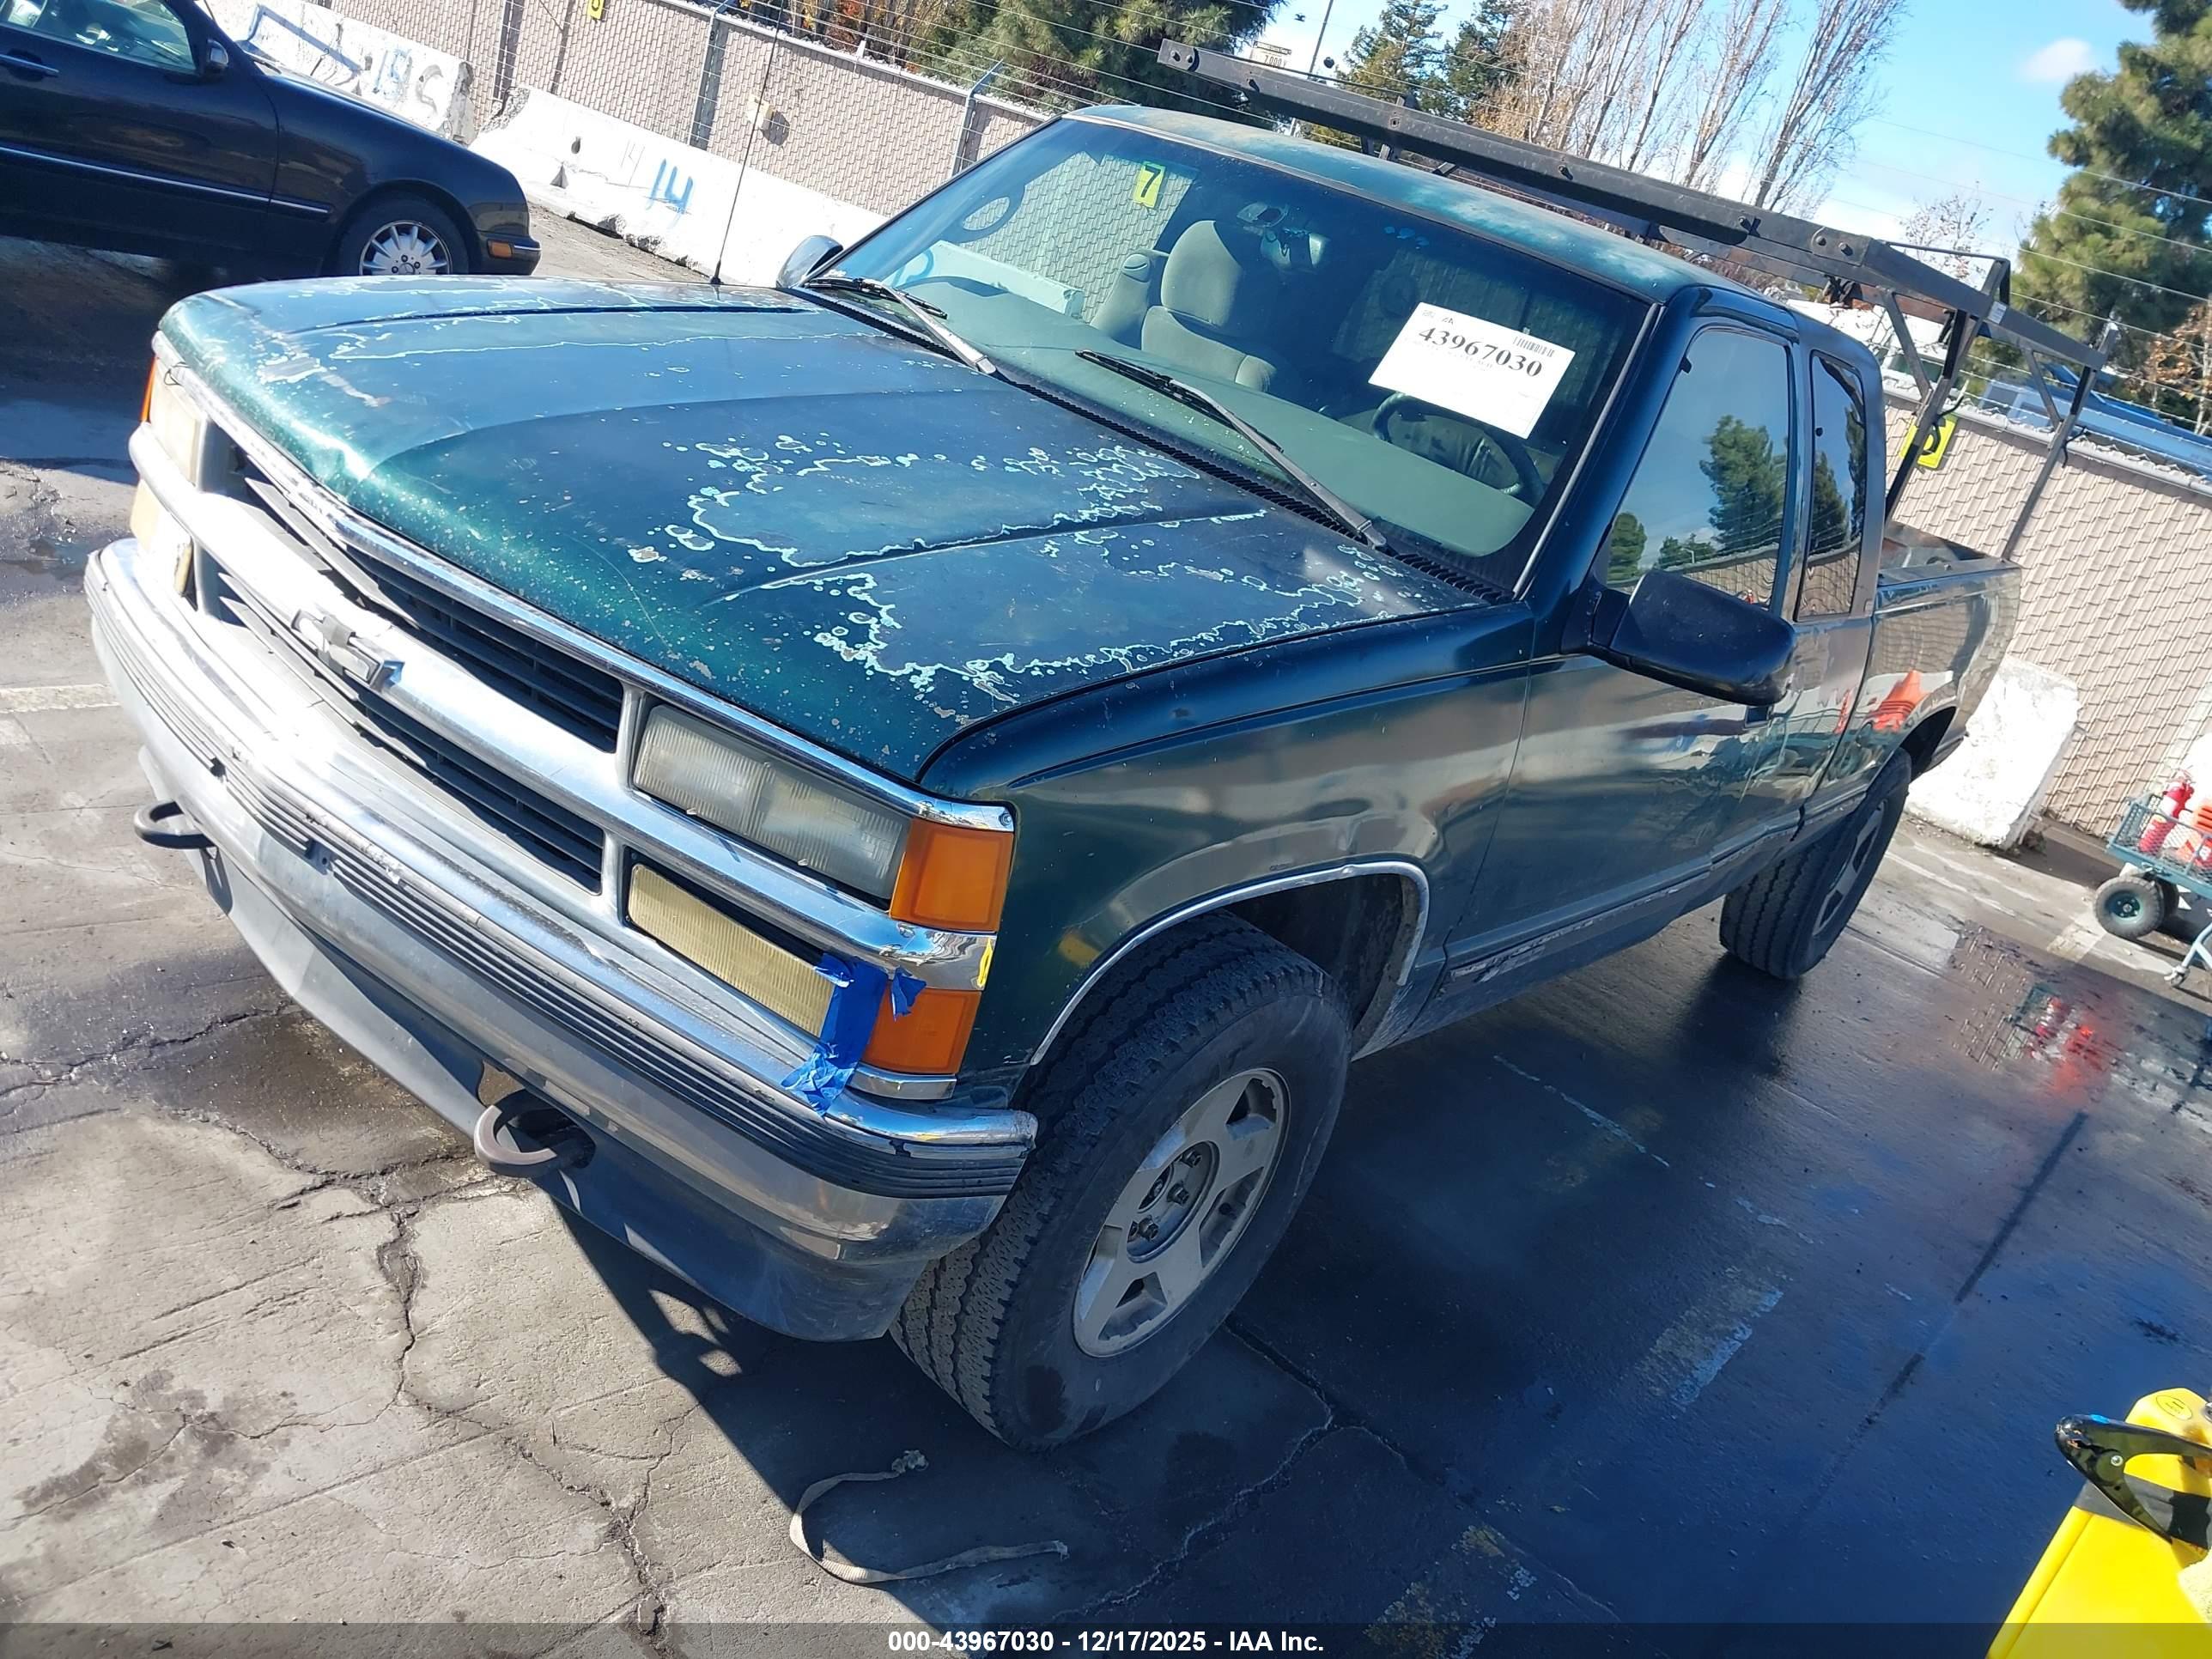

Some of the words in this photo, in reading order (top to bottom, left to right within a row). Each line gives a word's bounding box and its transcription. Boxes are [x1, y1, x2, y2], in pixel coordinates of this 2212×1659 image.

[647, 158, 694, 215] 14
[1140, 165, 1162, 198] 7
[1418, 327, 1543, 377] 43967030
